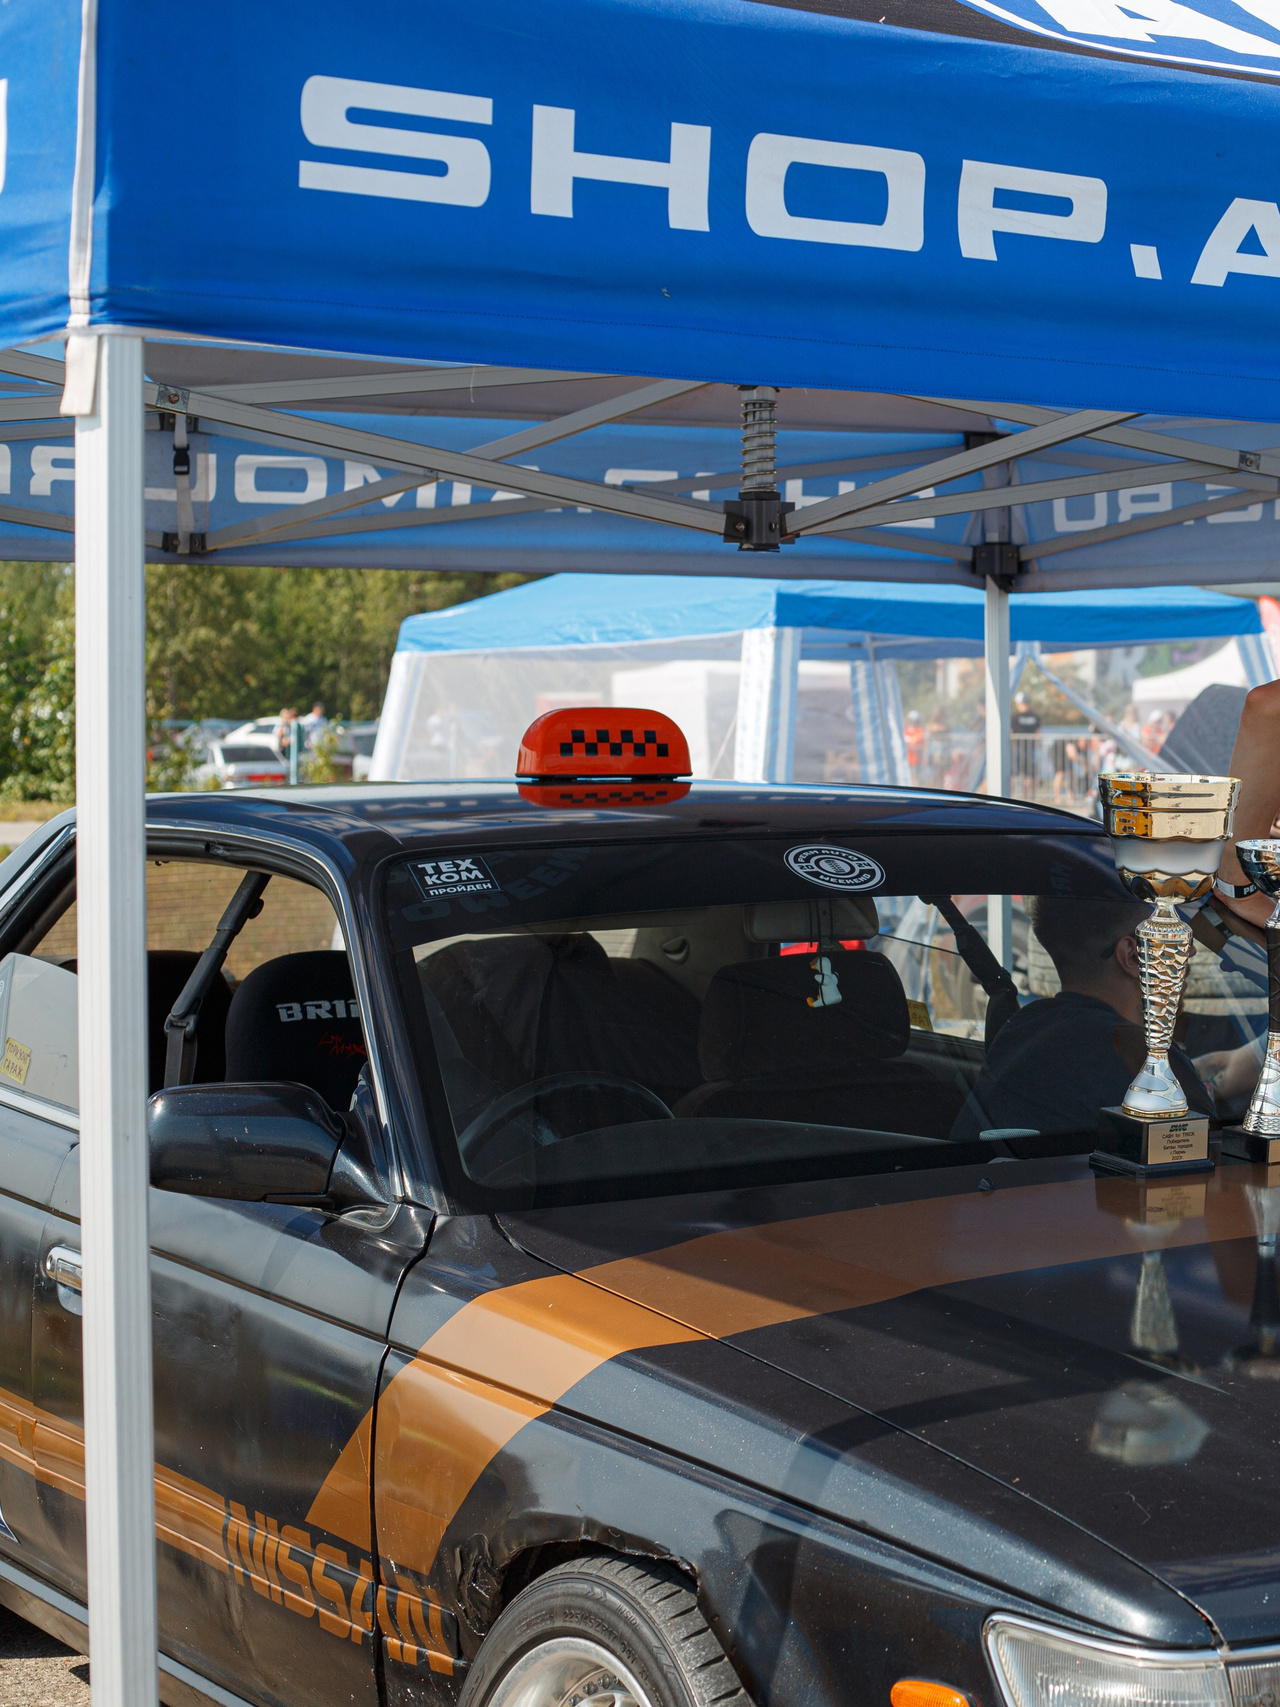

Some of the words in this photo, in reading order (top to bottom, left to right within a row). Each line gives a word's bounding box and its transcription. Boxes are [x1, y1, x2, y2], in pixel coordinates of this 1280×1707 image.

[417, 858, 479, 875] ТЕХ
[424, 870, 485, 885] КОМ
[429, 883, 493, 896] ПРОЙДЕН
[222, 1498, 455, 1677] NISSAN
